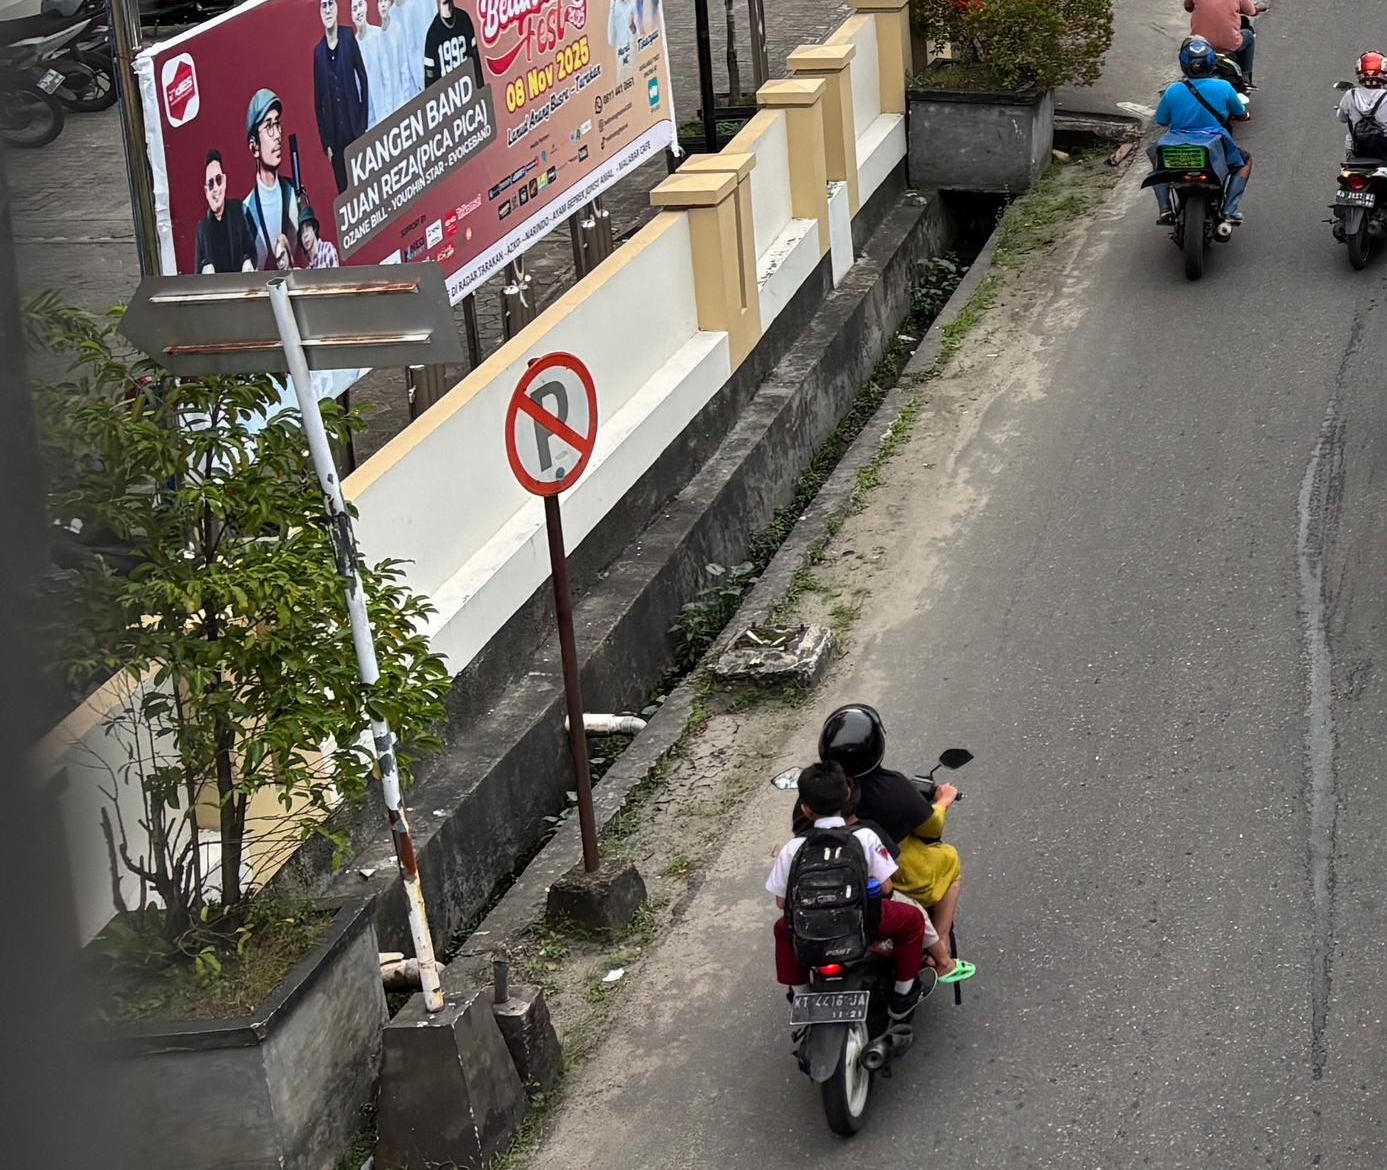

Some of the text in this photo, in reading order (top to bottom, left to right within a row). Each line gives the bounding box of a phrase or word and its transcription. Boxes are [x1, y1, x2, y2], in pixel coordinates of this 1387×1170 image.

[438, 35, 467, 76] 1992
[506, 77, 525, 113] 08
[556, 35, 589, 81] 2025
[338, 182, 380, 232] JUAN
[381, 128, 454, 200] REZA(PICA
[453, 98, 488, 142] PICA)
[351, 109, 424, 186] KANGEN
[425, 75, 473, 130] BAND
[343, 221, 371, 249] OZANE
[371, 208, 388, 228] BILL
[426, 161, 445, 184] STAR
[448, 124, 491, 167] EVOICEBAND
[850, 994, 866, 1006] JA
